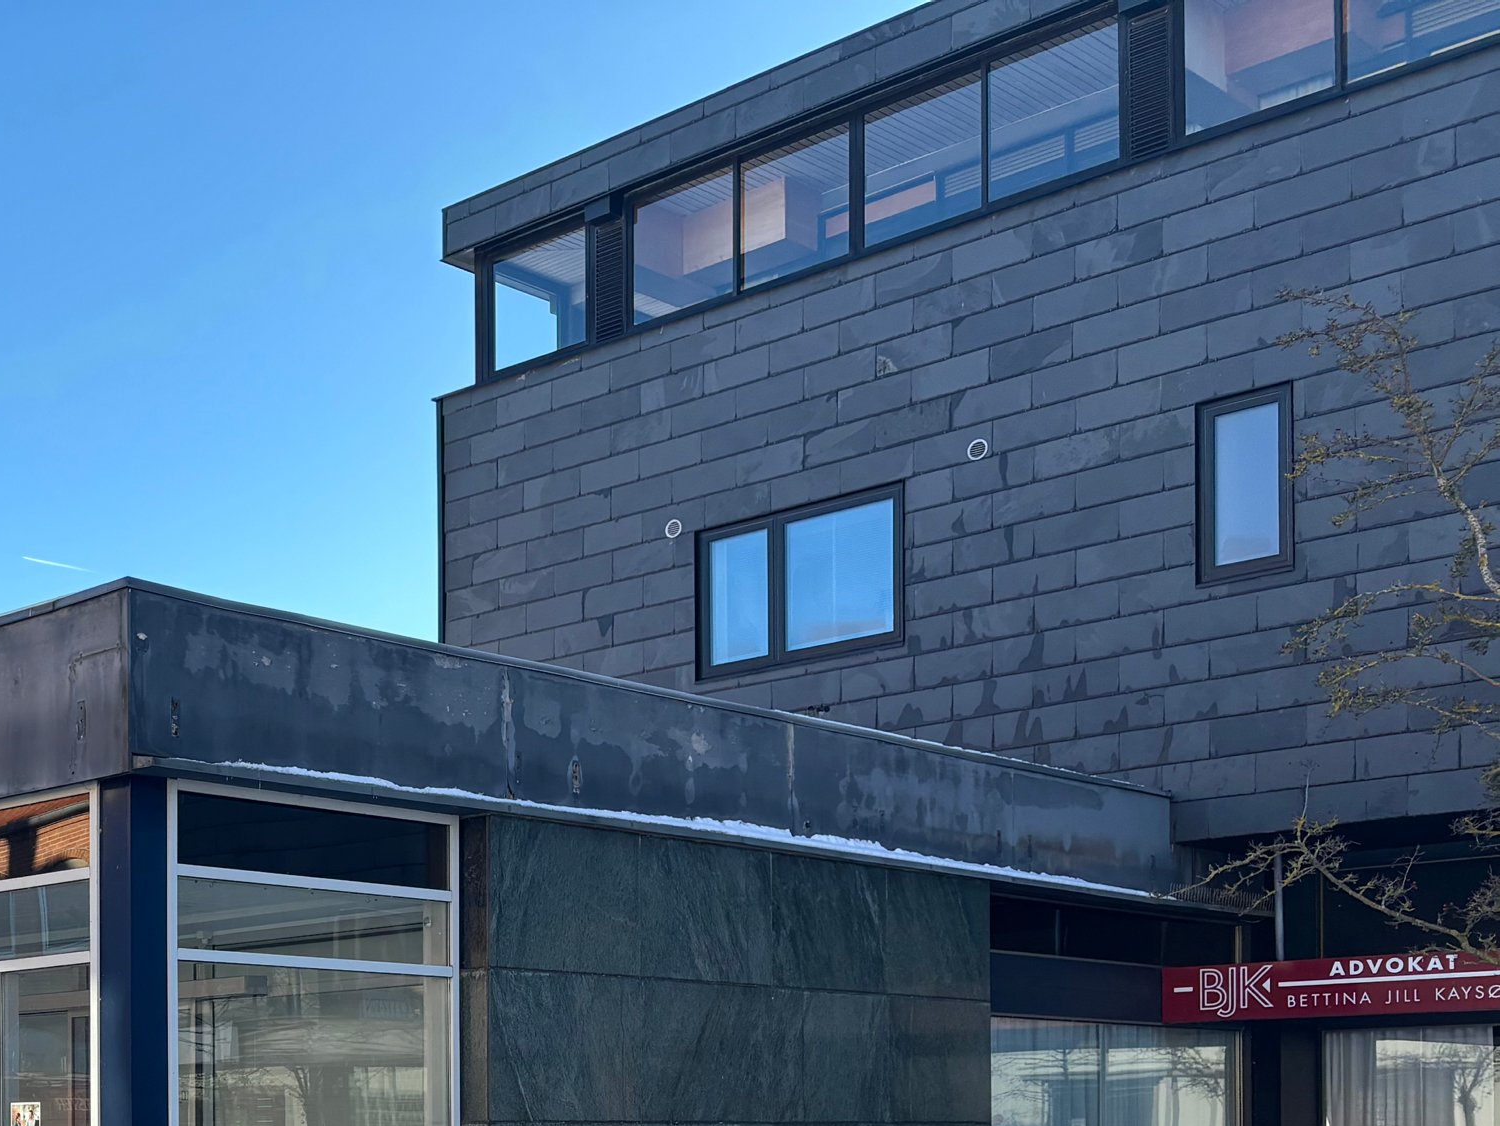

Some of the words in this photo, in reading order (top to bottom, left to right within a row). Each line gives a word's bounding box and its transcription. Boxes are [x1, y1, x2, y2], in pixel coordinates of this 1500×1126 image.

[1329, 954, 1458, 976] ADVOKAT
[1199, 964, 1274, 1018] BJK
[1287, 991, 1372, 1008] BETTINA
[1384, 989, 1421, 1004] JILL
